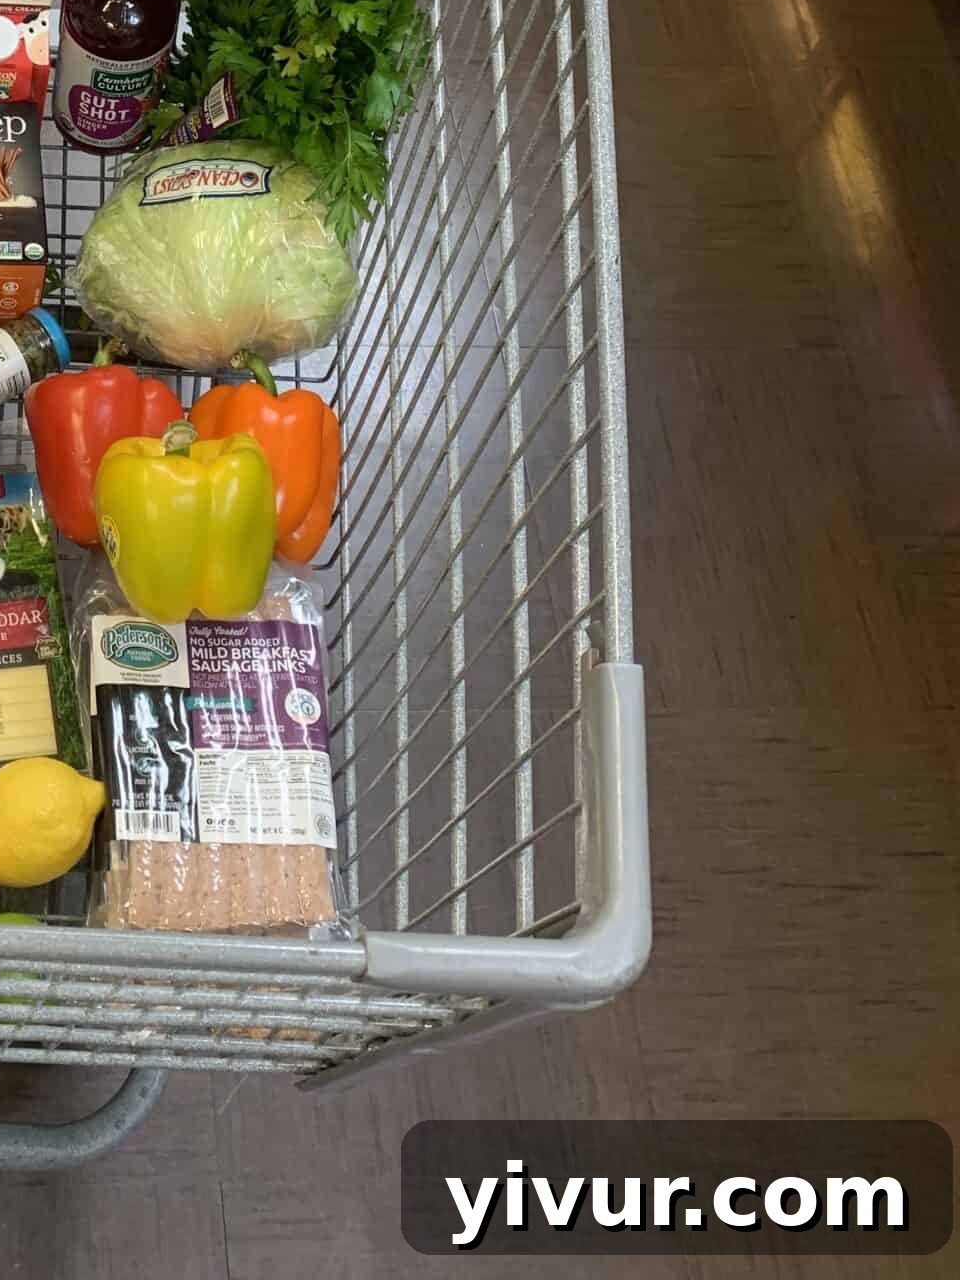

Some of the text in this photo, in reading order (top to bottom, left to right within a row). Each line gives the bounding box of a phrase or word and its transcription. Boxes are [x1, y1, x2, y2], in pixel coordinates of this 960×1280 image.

[80, 91, 120, 110] GUT
[79, 102, 130, 121] SHOT
[190, 637, 280, 648] NO SUGAR ADDED
[191, 646, 229, 660] MILD
[191, 659, 307, 674] SAUSAGE LINKS
